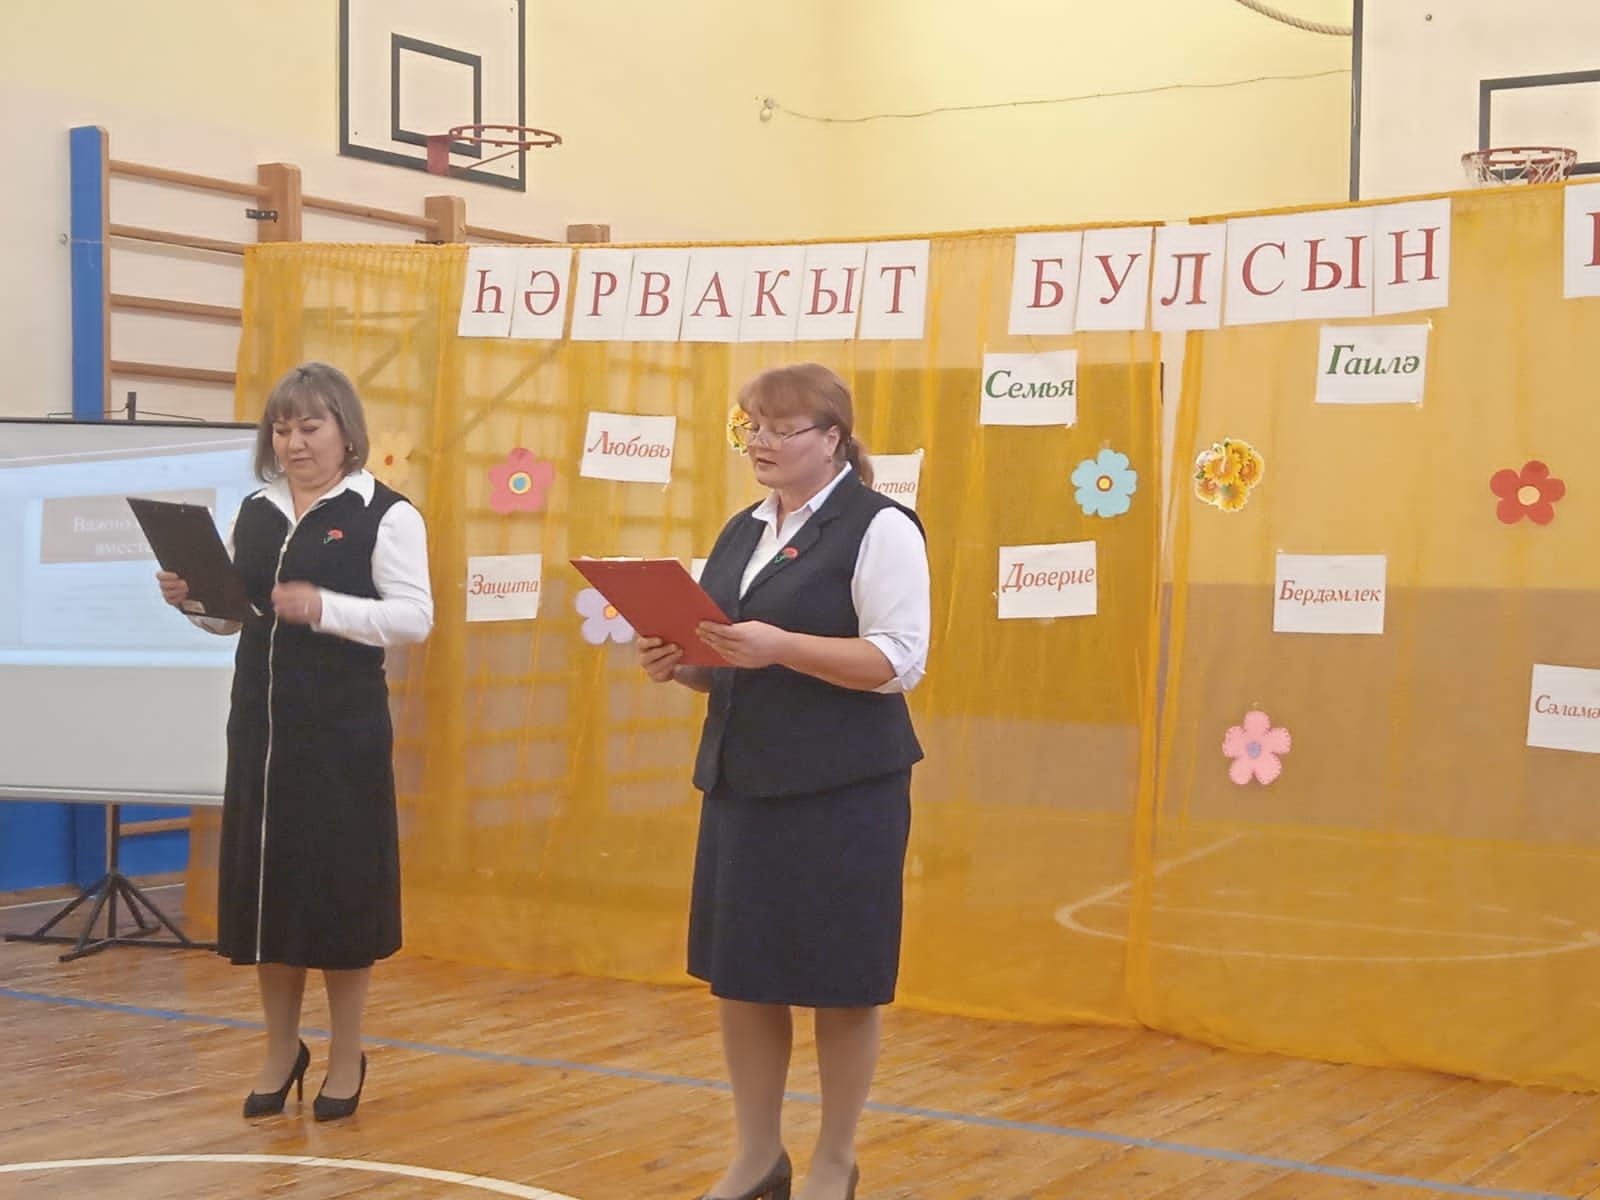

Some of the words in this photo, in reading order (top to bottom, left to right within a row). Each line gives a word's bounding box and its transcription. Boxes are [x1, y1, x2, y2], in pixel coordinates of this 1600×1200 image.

[1026, 226, 1441, 309] БУЛСЫН
[1325, 344, 1420, 376] Гаилә
[984, 369, 1075, 399] Семья
[587, 430, 671, 459] Любовь
[468, 573, 538, 599] Защита
[1001, 562, 1095, 593] Доверие
[1279, 579, 1382, 607] Бердәмлек
